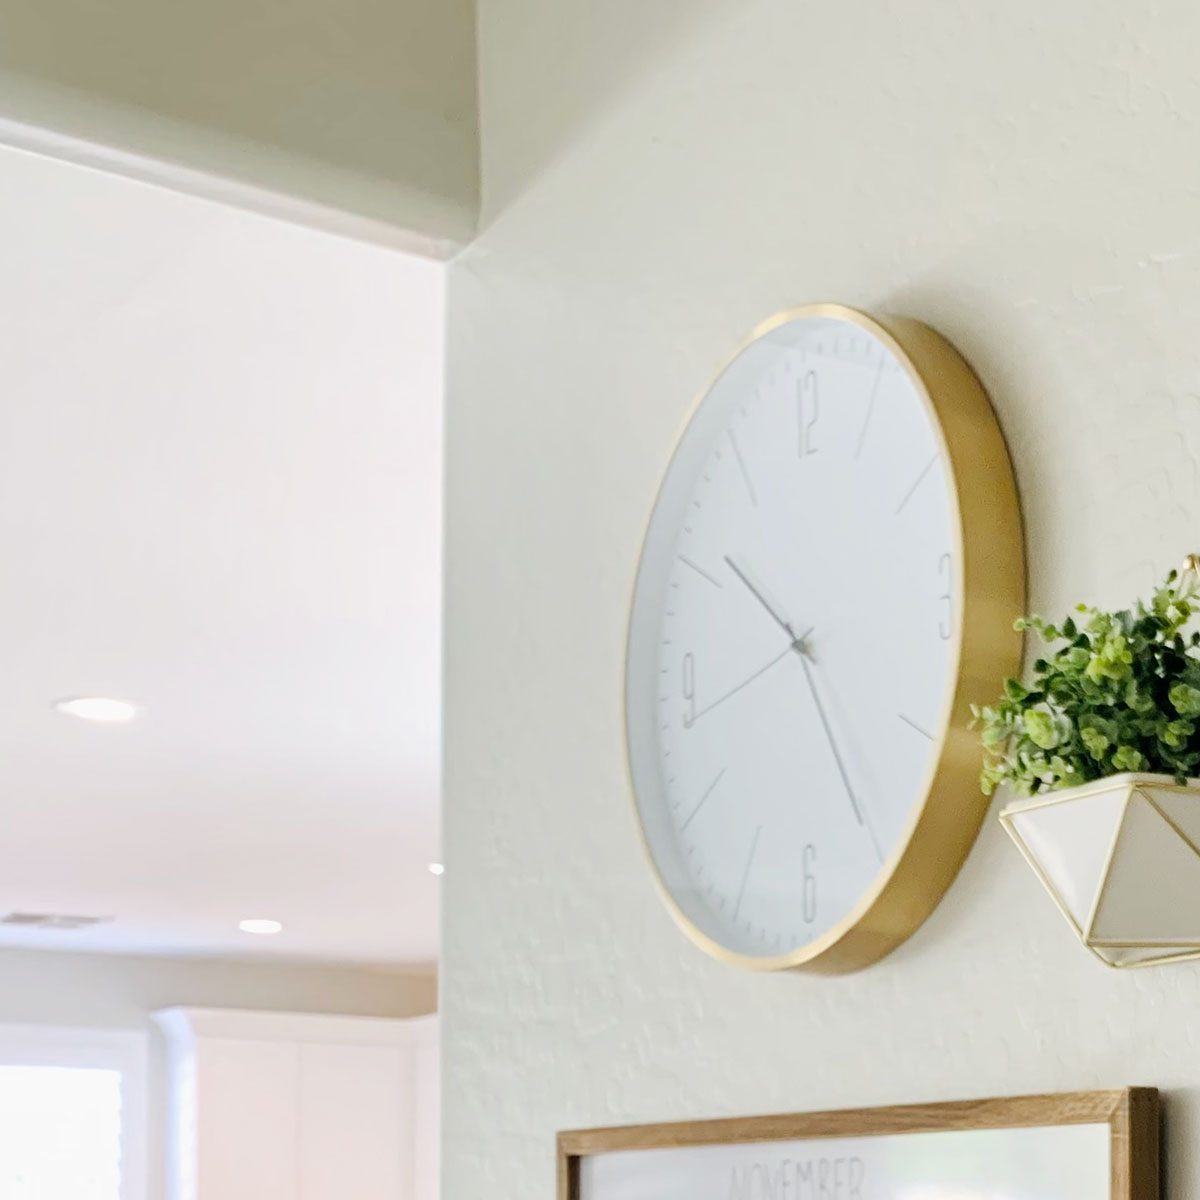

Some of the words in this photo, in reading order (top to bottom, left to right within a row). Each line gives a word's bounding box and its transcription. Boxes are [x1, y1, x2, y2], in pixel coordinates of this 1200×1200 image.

[796, 369, 821, 460] 12
[936, 551, 954, 641] 3
[682, 652, 698, 729] 9
[801, 843, 818, 924] 6
